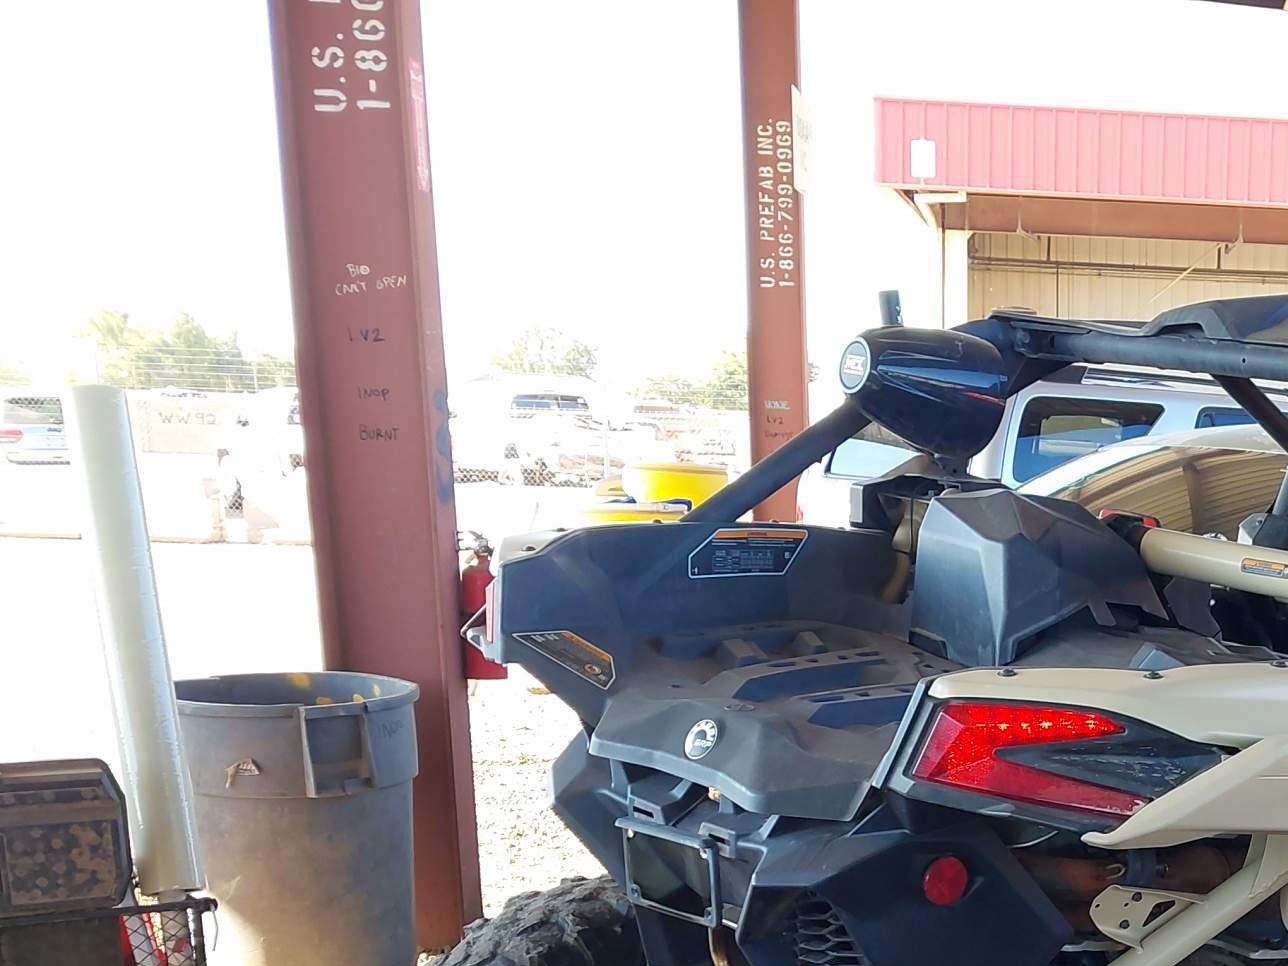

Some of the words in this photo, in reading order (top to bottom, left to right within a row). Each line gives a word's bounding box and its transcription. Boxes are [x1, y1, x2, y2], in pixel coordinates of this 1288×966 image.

[311, 33, 347, 112] U.S.
[757, 118, 774, 156] INC.
[758, 165, 775, 241] PREFAB
[759, 252, 776, 288] U.S.
[359, 423, 401, 441] BURNT
